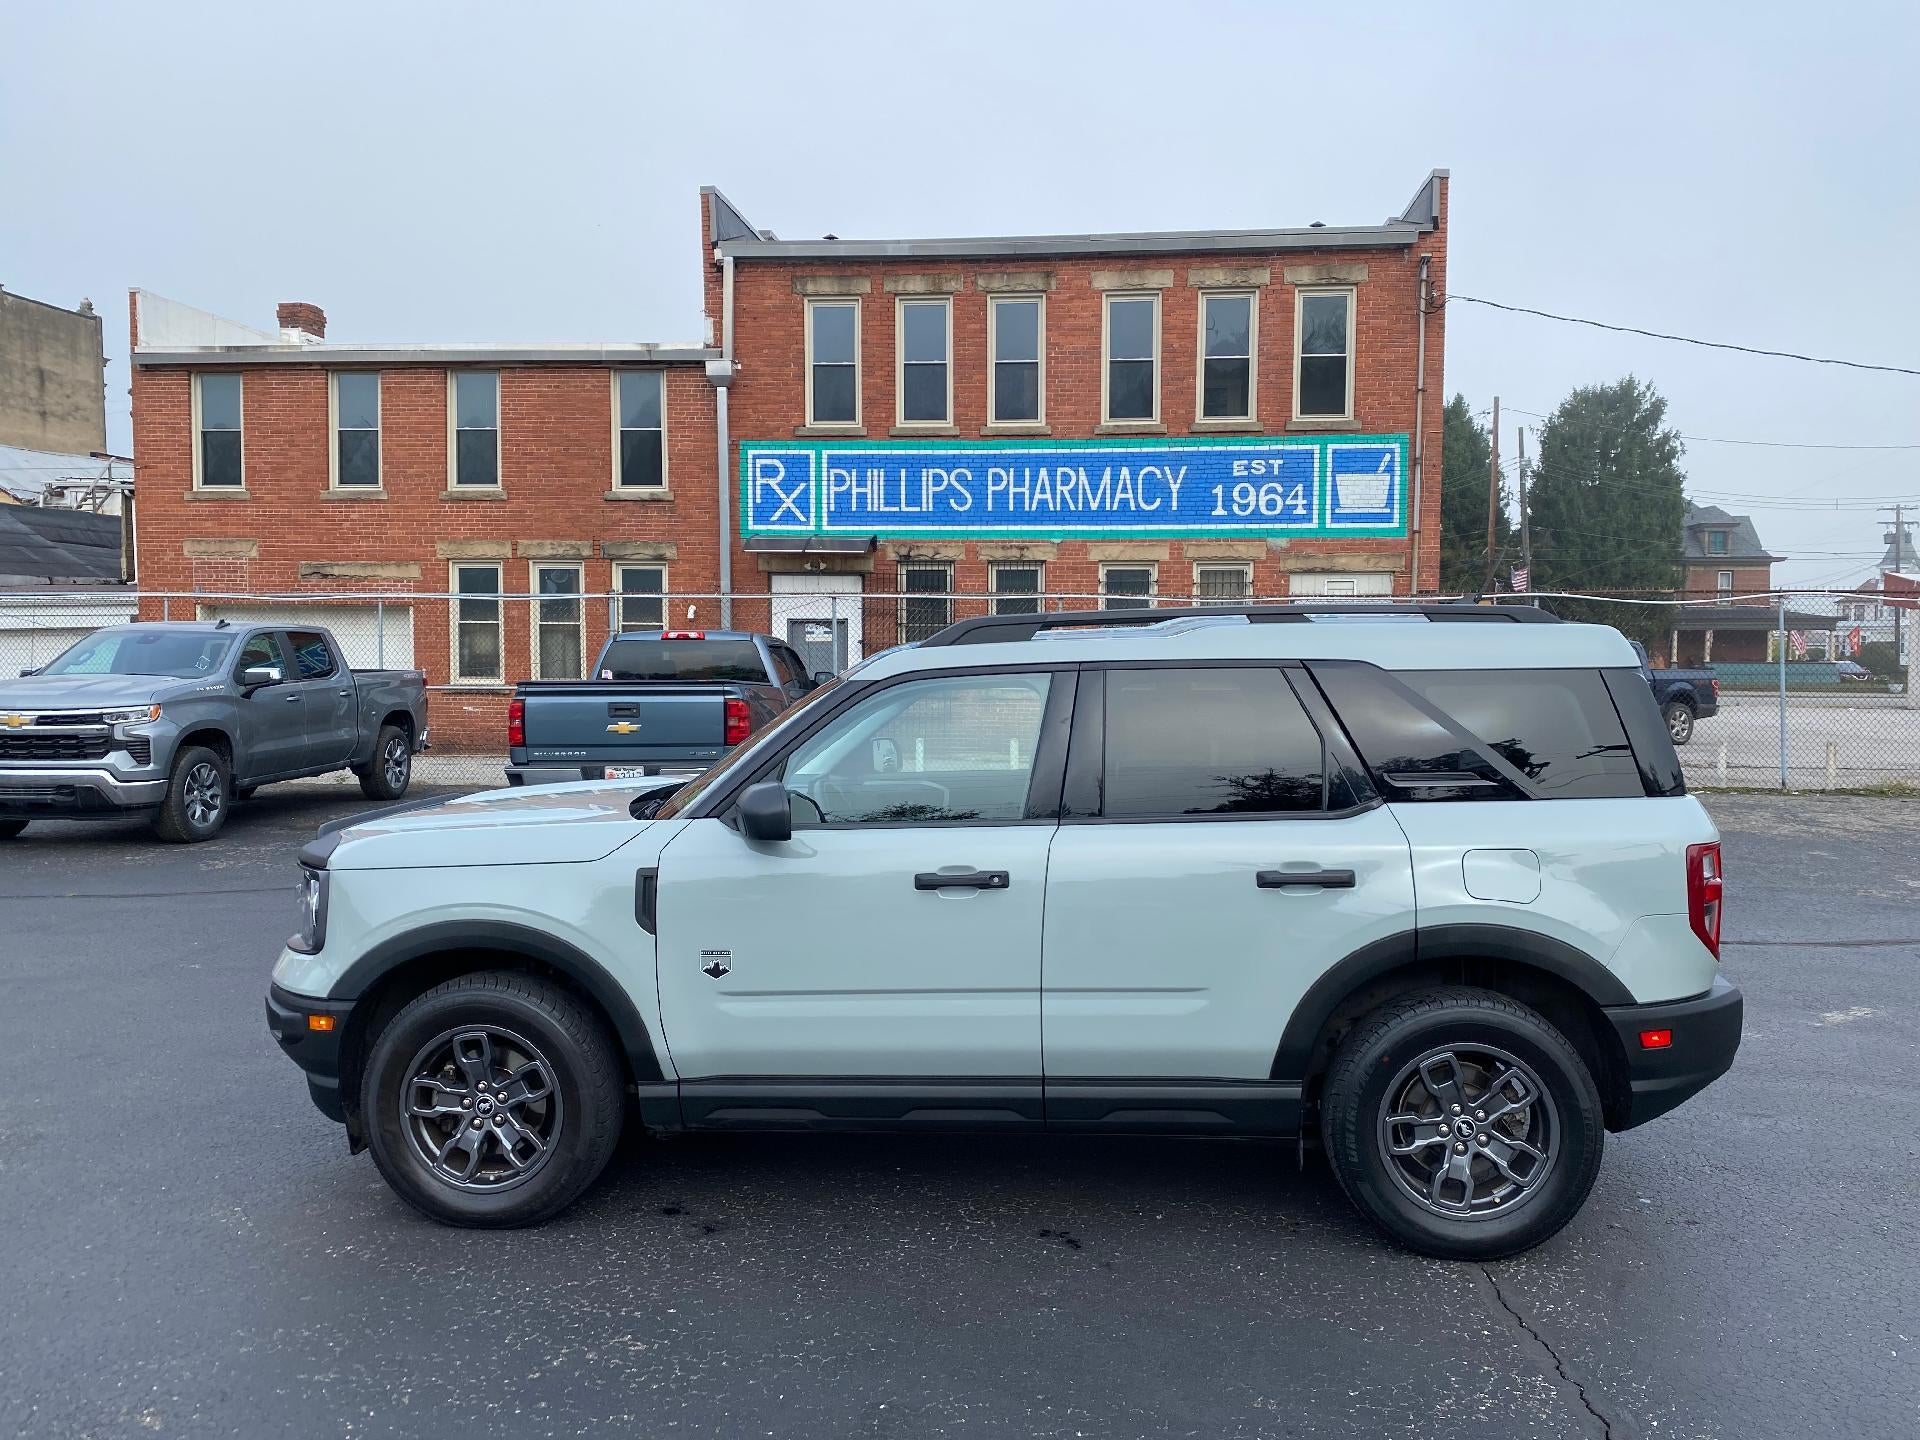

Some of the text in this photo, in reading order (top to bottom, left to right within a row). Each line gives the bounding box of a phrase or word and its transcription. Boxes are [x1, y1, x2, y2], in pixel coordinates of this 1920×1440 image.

[1232, 459, 1284, 477] EST
[829, 466, 1187, 512] PHILLIPS PHARMACY
[1211, 482, 1308, 517] 1964
